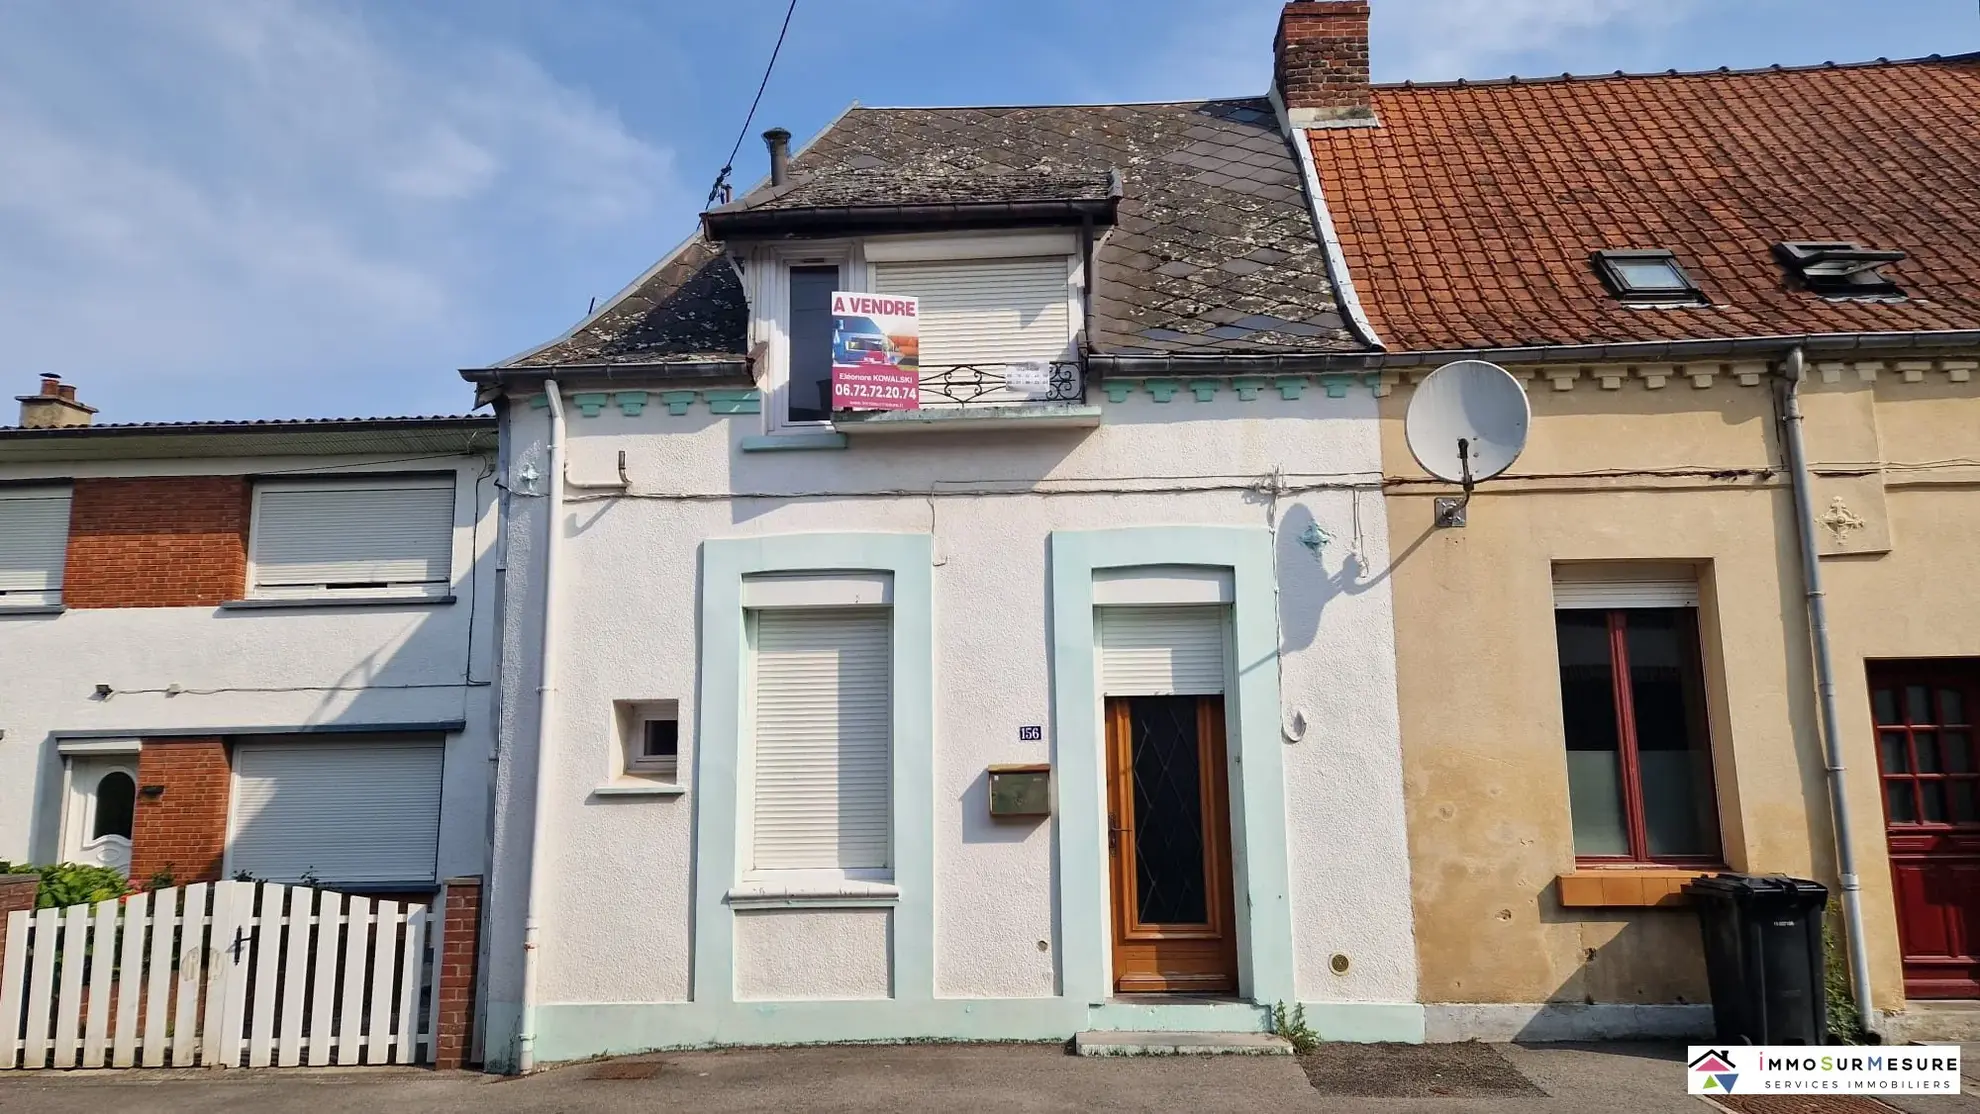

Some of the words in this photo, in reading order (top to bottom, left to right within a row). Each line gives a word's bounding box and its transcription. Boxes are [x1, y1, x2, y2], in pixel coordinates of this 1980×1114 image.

[834, 297, 845, 312] A
[849, 297, 916, 317] VENDRE
[872, 374, 913, 384] KOWALSKI
[835, 383, 917, 400] 06.72.72.20.74
[1021, 727, 1040, 739] 156
